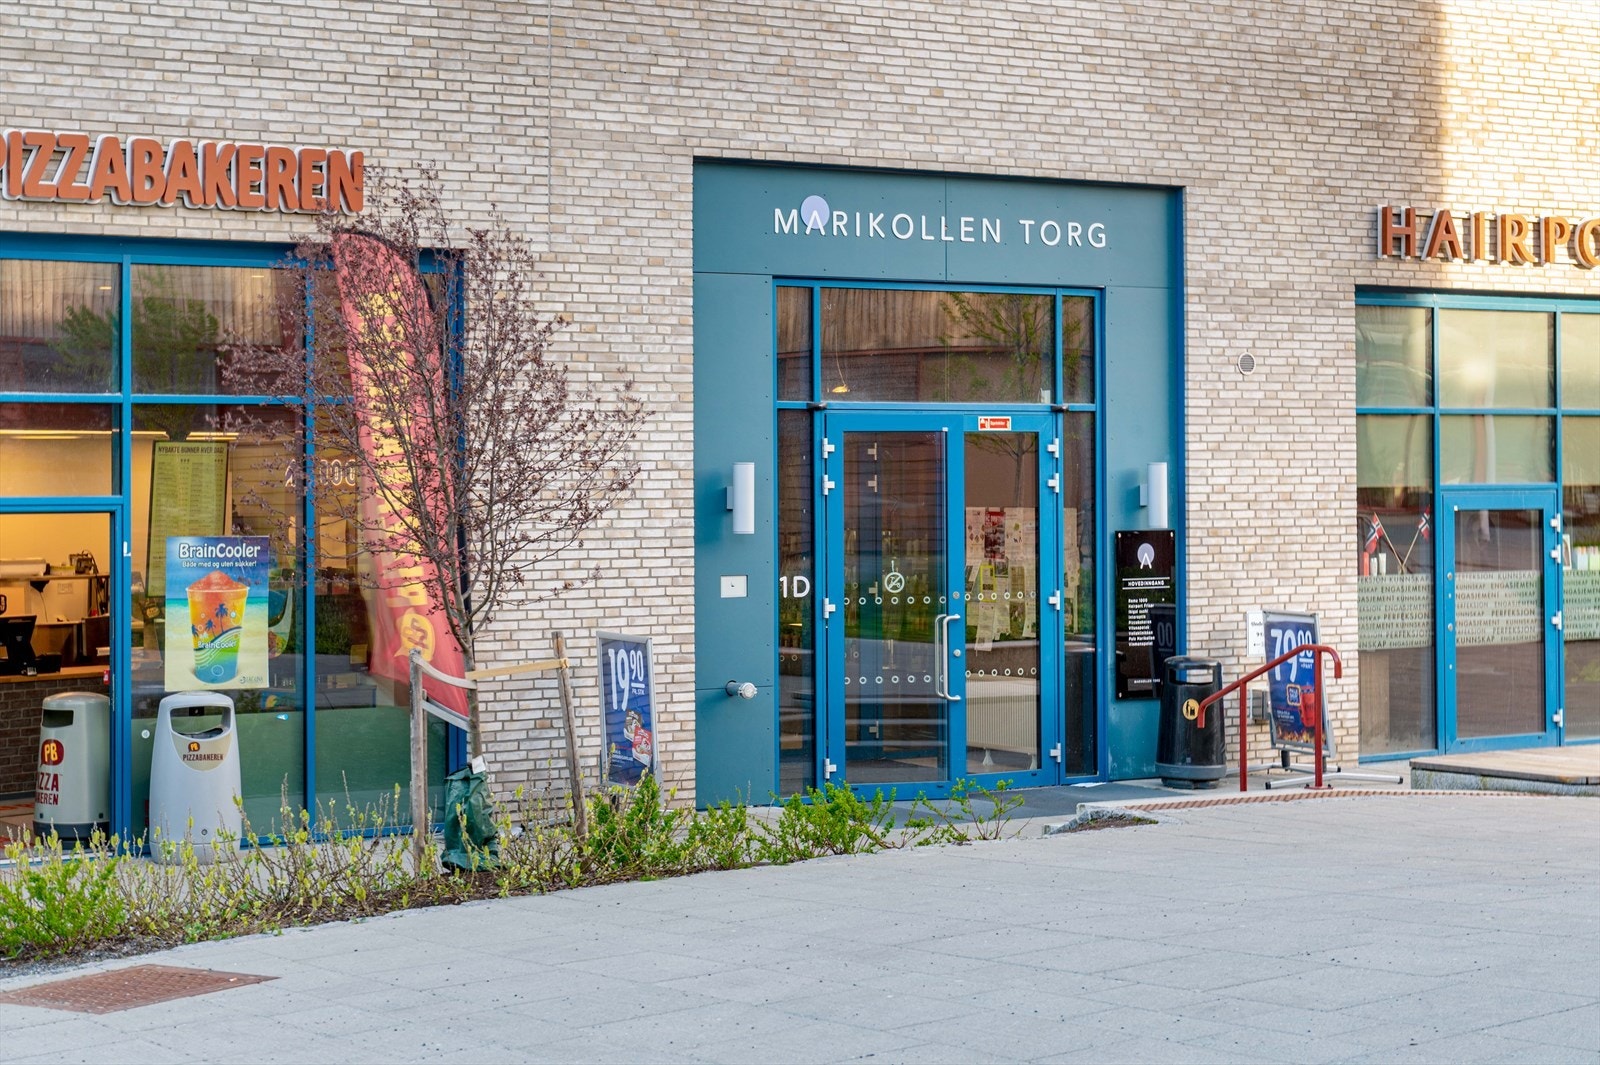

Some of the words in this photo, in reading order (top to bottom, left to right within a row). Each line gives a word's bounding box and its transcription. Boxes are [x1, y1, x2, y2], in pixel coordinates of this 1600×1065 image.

[773, 208, 1001, 243] MARIKOLLEN
[1019, 219, 1106, 248] TORG
[180, 543, 260, 558] BrainCooler
[779, 575, 810, 599] 1D
[1491, 608, 1536, 617] PERFEKSJON
[1270, 629, 1298, 683] 79
[608, 648, 630, 711] 19
[630, 649, 644, 682] 90
[44, 742, 59, 763] PB
